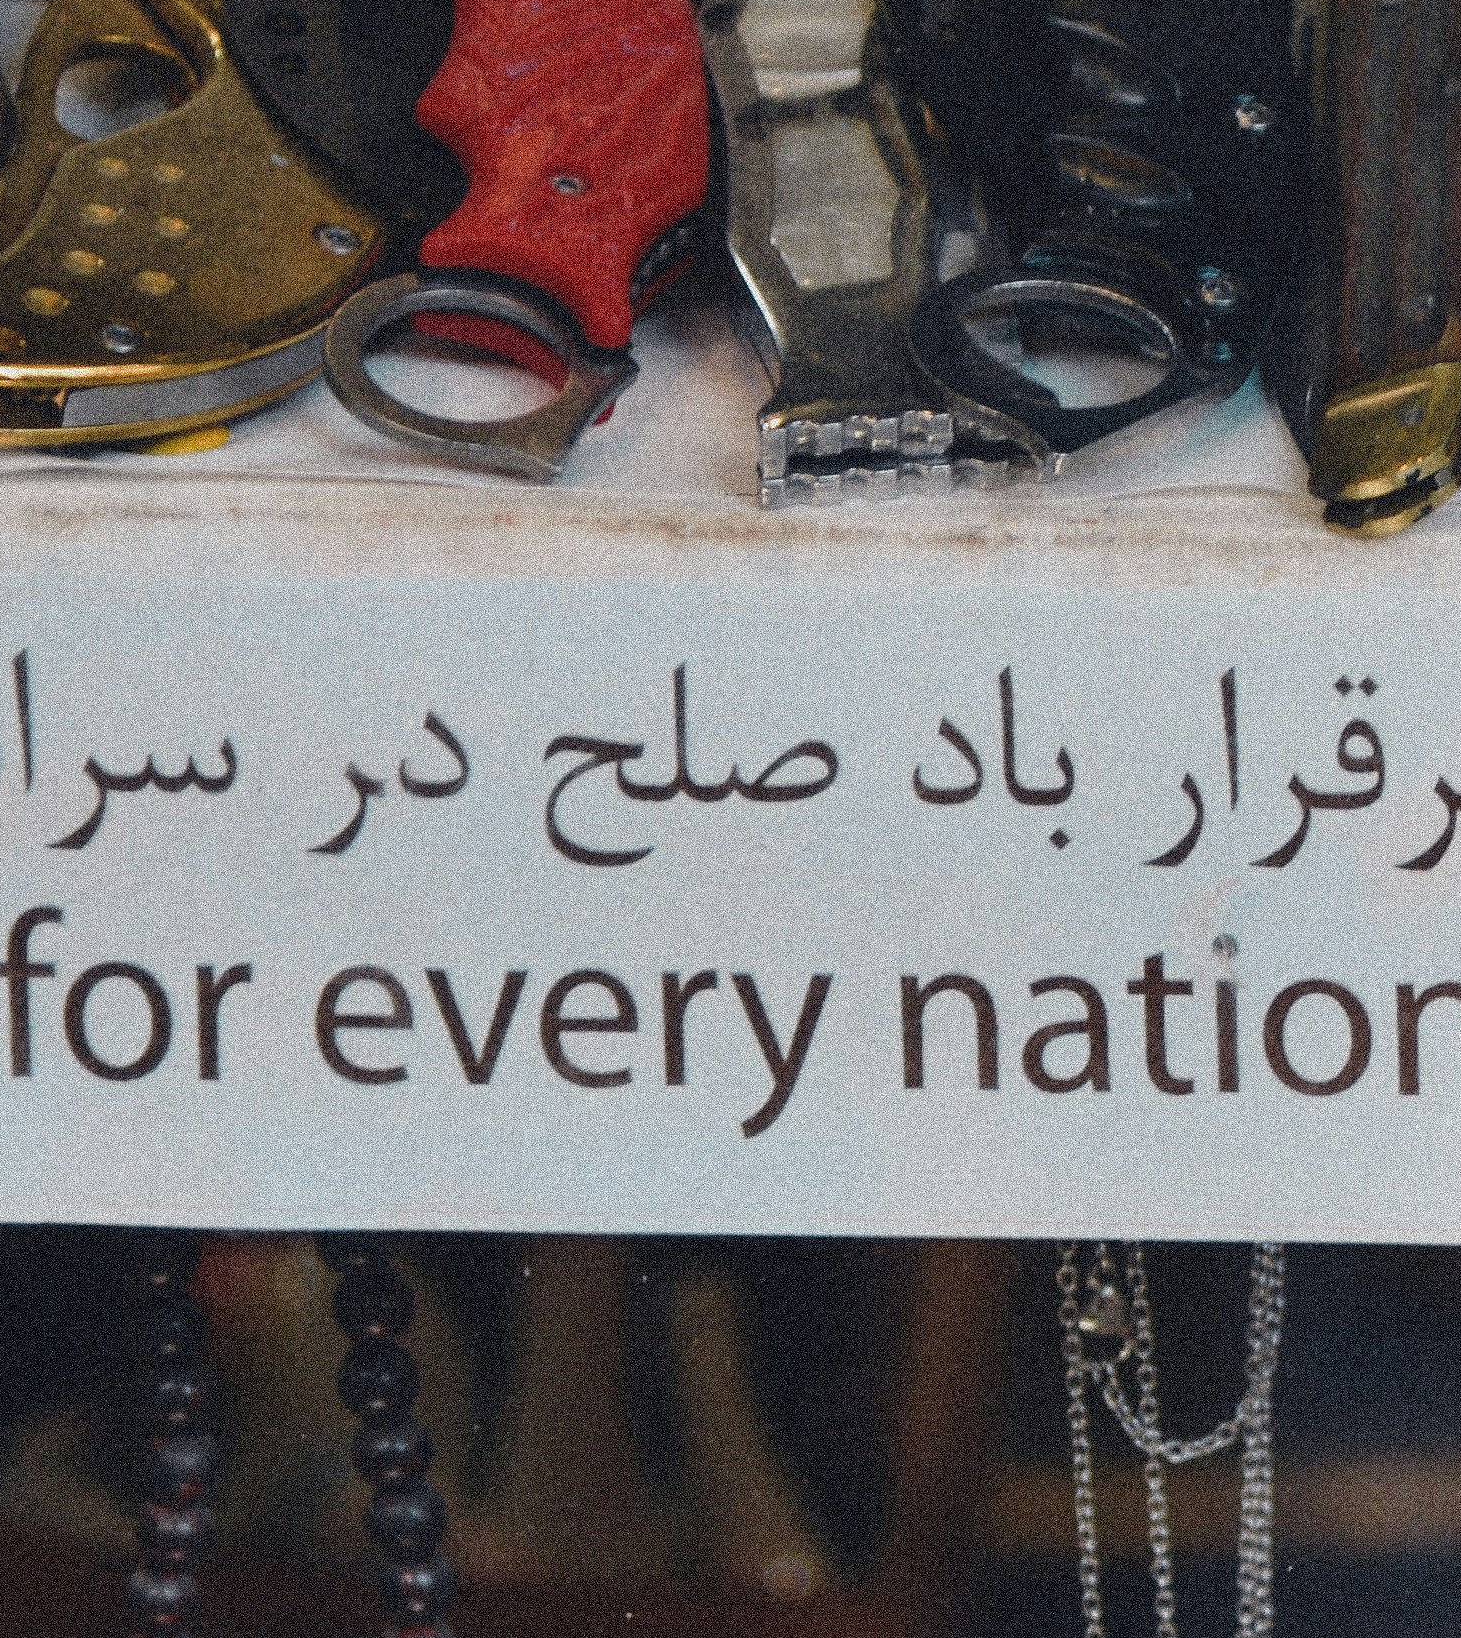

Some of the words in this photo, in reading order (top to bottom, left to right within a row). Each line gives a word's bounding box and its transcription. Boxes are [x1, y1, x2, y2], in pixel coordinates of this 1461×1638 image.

[309, 710, 472, 859] در
[542, 662, 842, 871] صلح
[909, 665, 1077, 852] باد
[313, 963, 835, 1141] every
